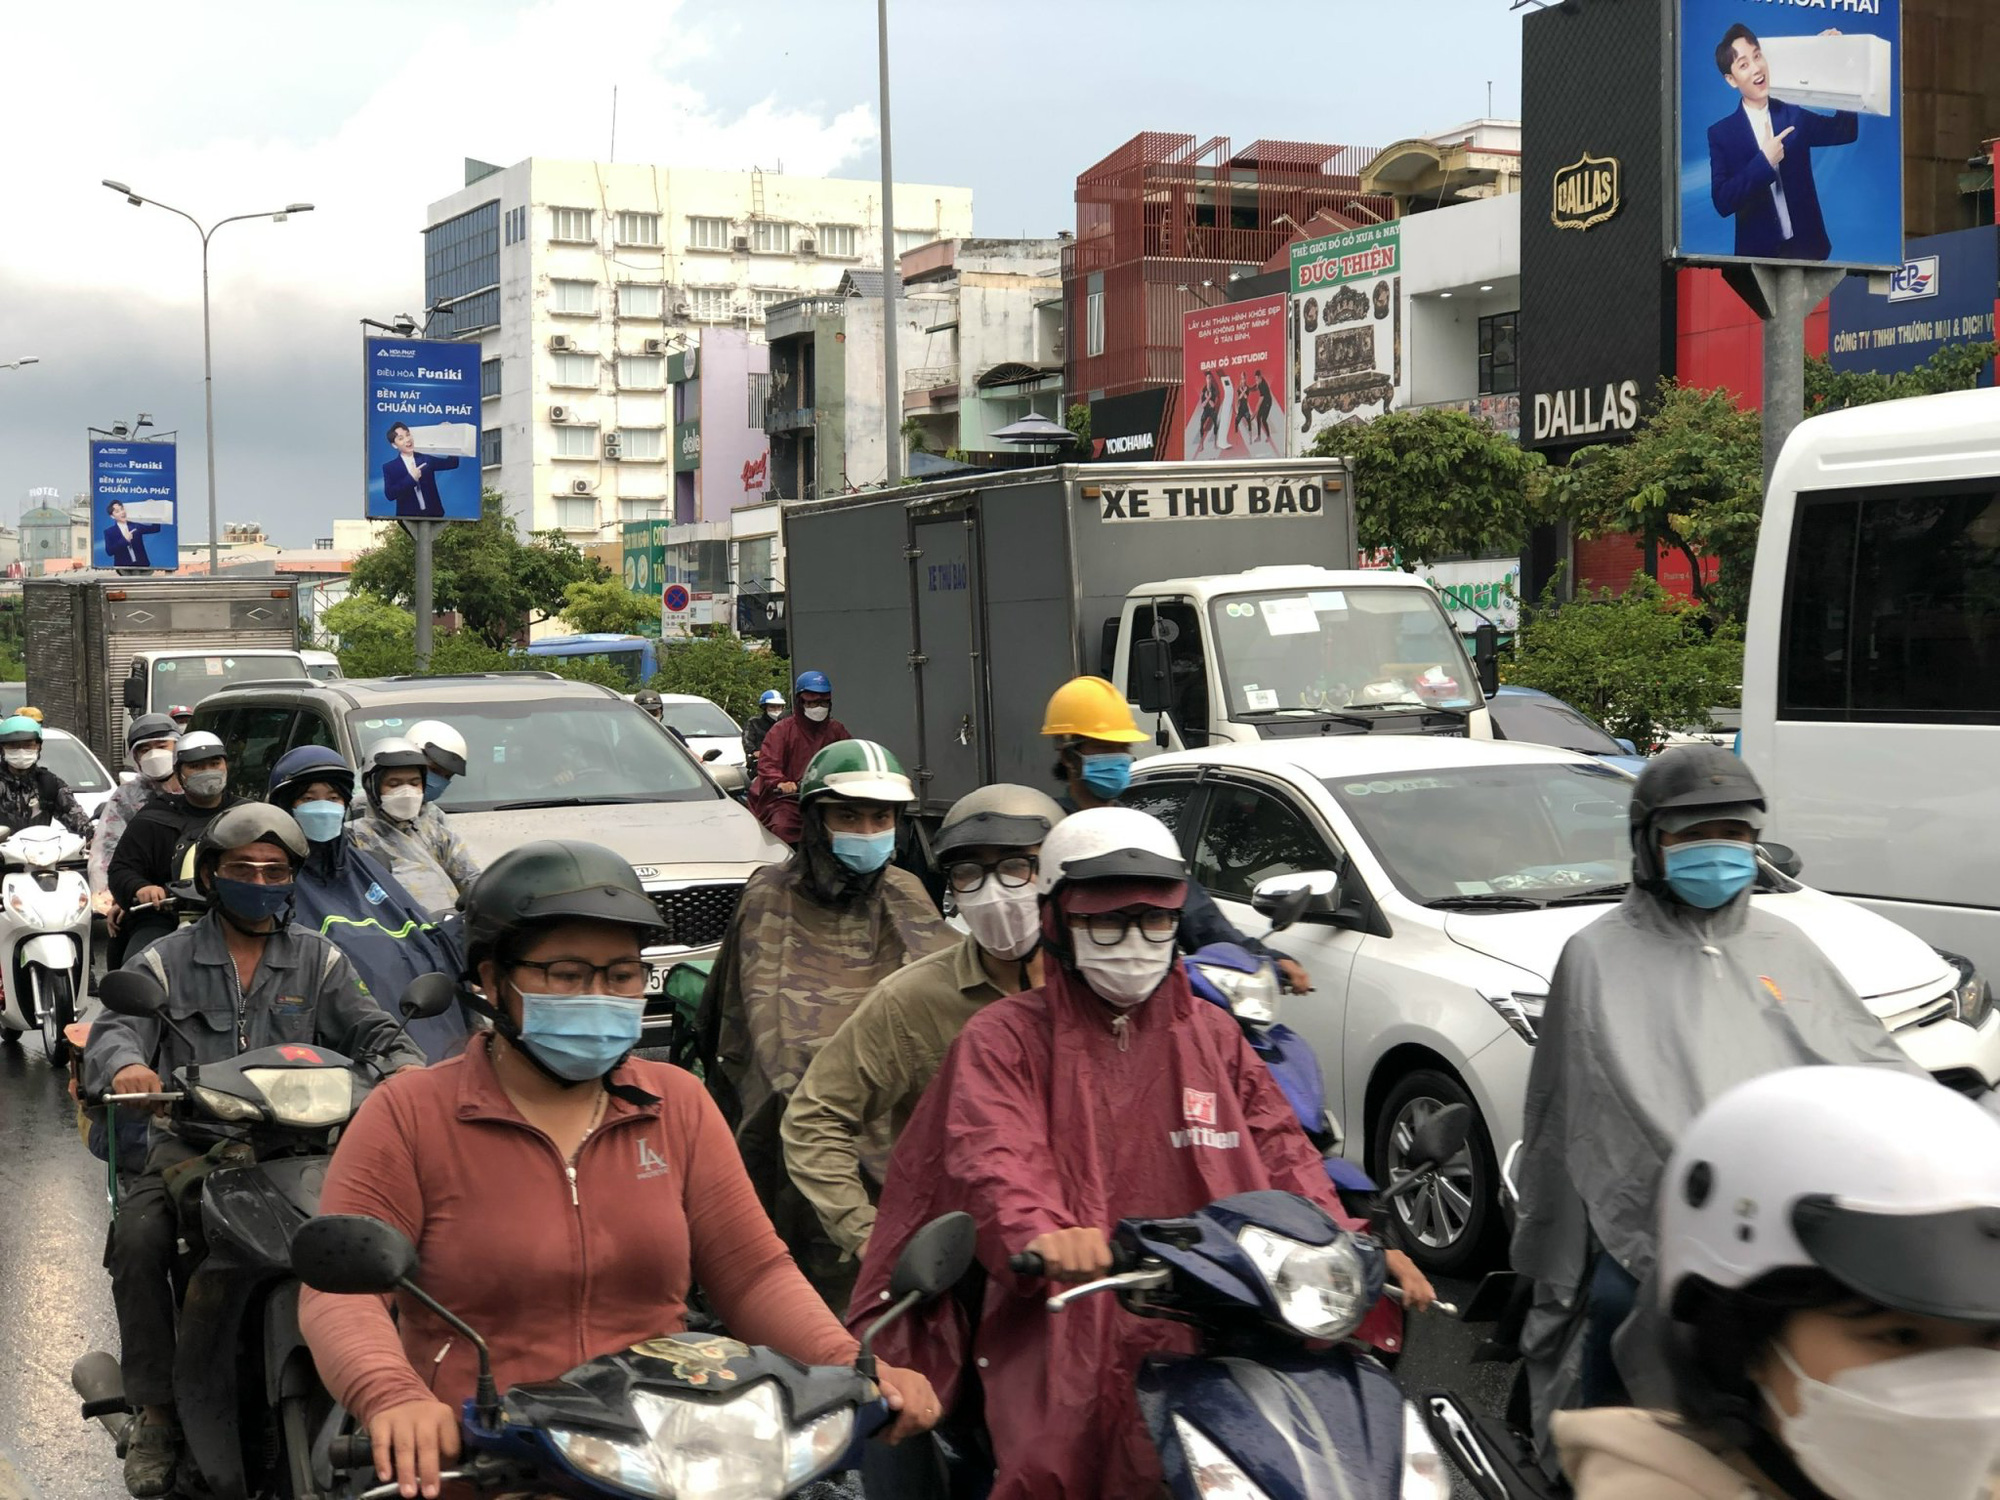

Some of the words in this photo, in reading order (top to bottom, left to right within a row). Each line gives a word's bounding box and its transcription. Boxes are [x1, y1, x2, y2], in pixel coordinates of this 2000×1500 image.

[1558, 170, 1612, 215] DALLAS
[1375, 229, 1382, 239] &
[1383, 224, 1400, 237] NAY
[1299, 255, 1339, 287] ĐỨC
[1341, 243, 1396, 277] THIỆN
[1834, 330, 1857, 353] CÔNG
[1858, 330, 1871, 351] TY
[1873, 327, 1896, 348] TNHH
[1898, 320, 1933, 344] THƯƠNG
[1935, 319, 1951, 342] MẠI
[1953, 317, 1960, 337] &
[1962, 313, 1984, 340] DỊCH
[1200, 360, 1216, 371] BẠN
[1218, 355, 1230, 367] CÓ
[376, 367, 395, 377] ĐIỀU
[396, 368, 415, 378] HÒA
[417, 367, 462, 380] Funiki
[376, 387, 397, 398] BỀN
[400, 389, 421, 399] MÁT
[376, 400, 416, 413] CHUẨN
[418, 402, 443, 414] HÒA
[445, 403, 473, 415] PHÁT
[1534, 380, 1639, 440] DALLAS
[1105, 432, 1154, 455] YOKOHAMA
[129, 460, 163, 469] Funiki
[116, 476, 132, 484] MÁT
[29, 486, 60, 497] HOTEL
[98, 484, 128, 493] CHUẨN
[130, 485, 148, 494] HÒA
[149, 486, 171, 495] PHÁT
[1102, 489, 1150, 518] XE
[1163, 484, 1238, 516] THƯ
[1248, 479, 1321, 514] BÁO
[635, 867, 657, 876] KIA
